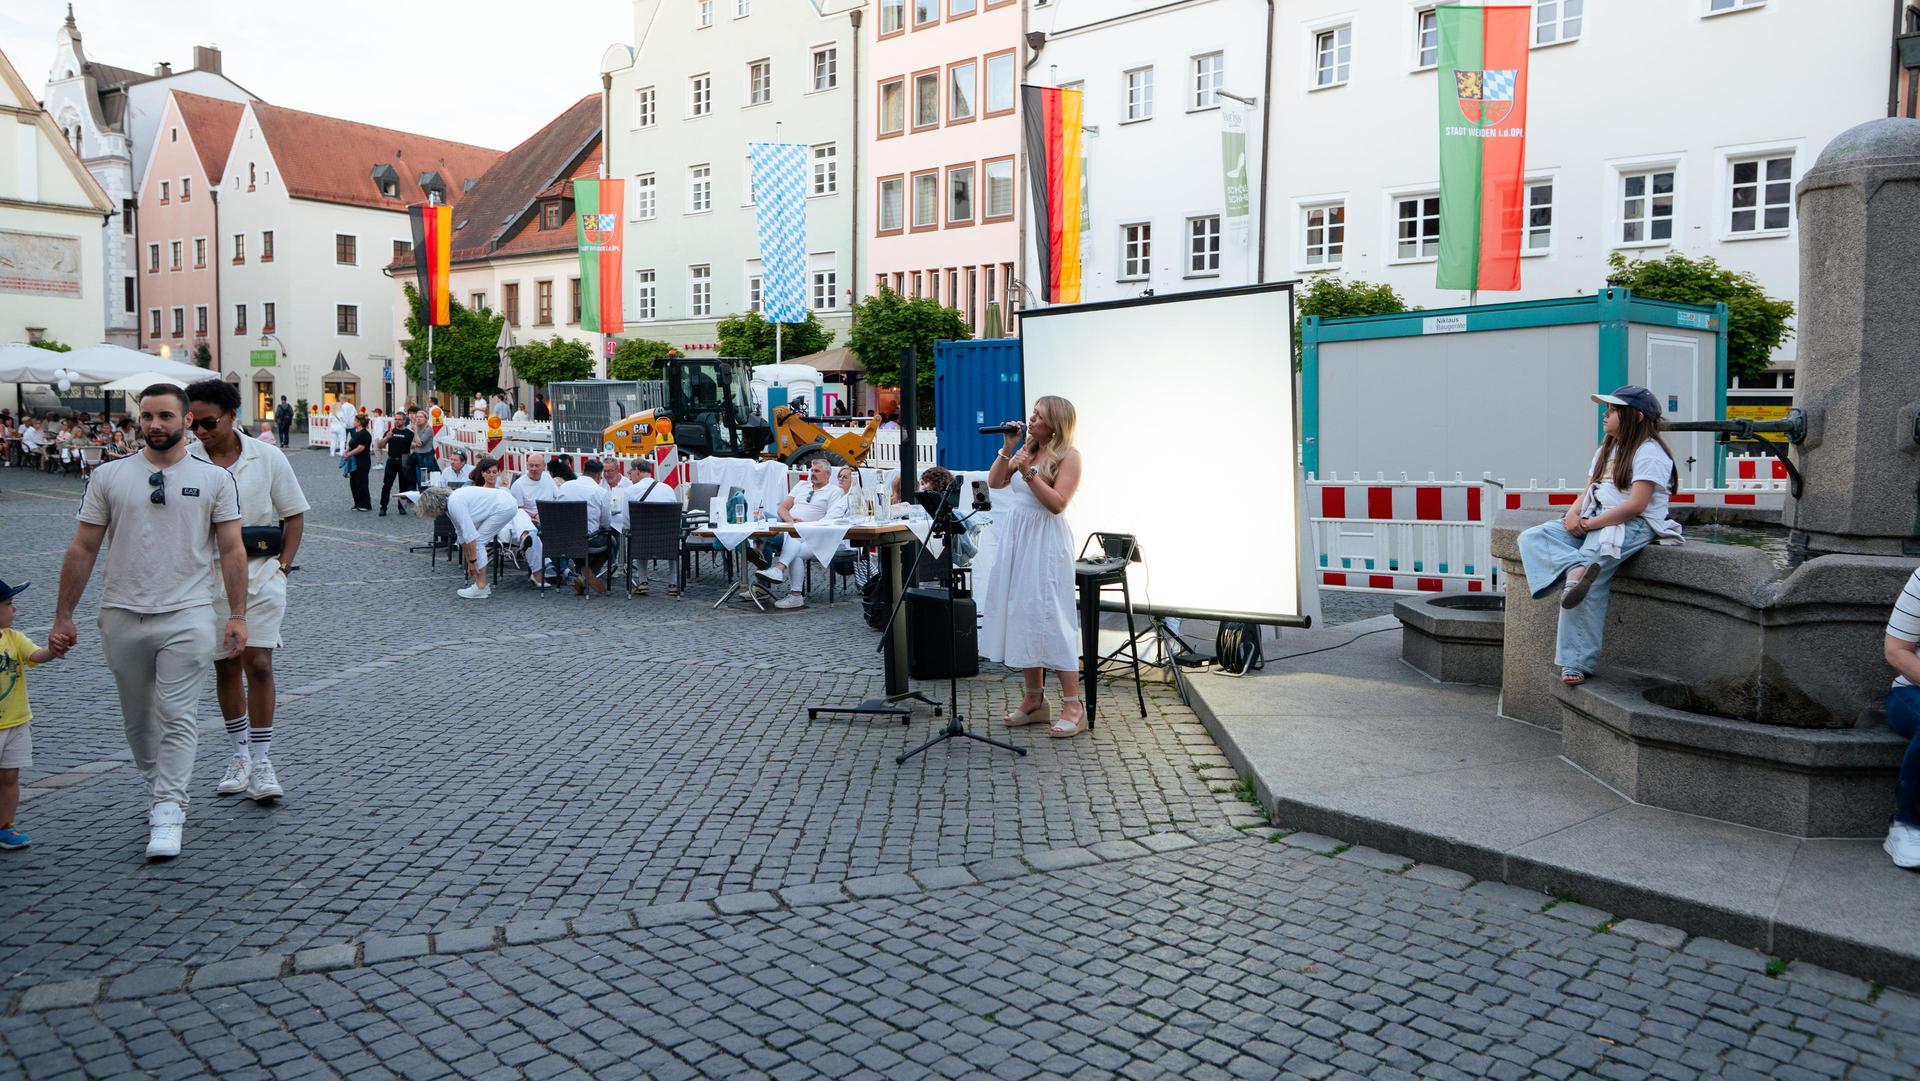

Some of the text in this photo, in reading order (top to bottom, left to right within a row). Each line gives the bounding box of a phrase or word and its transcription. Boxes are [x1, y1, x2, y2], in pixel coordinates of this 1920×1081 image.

[1445, 126, 1466, 136] STADT
[1468, 127, 1496, 137] WEIDEN
[607, 341, 616, 354] T
[633, 424, 648, 433] CAT
